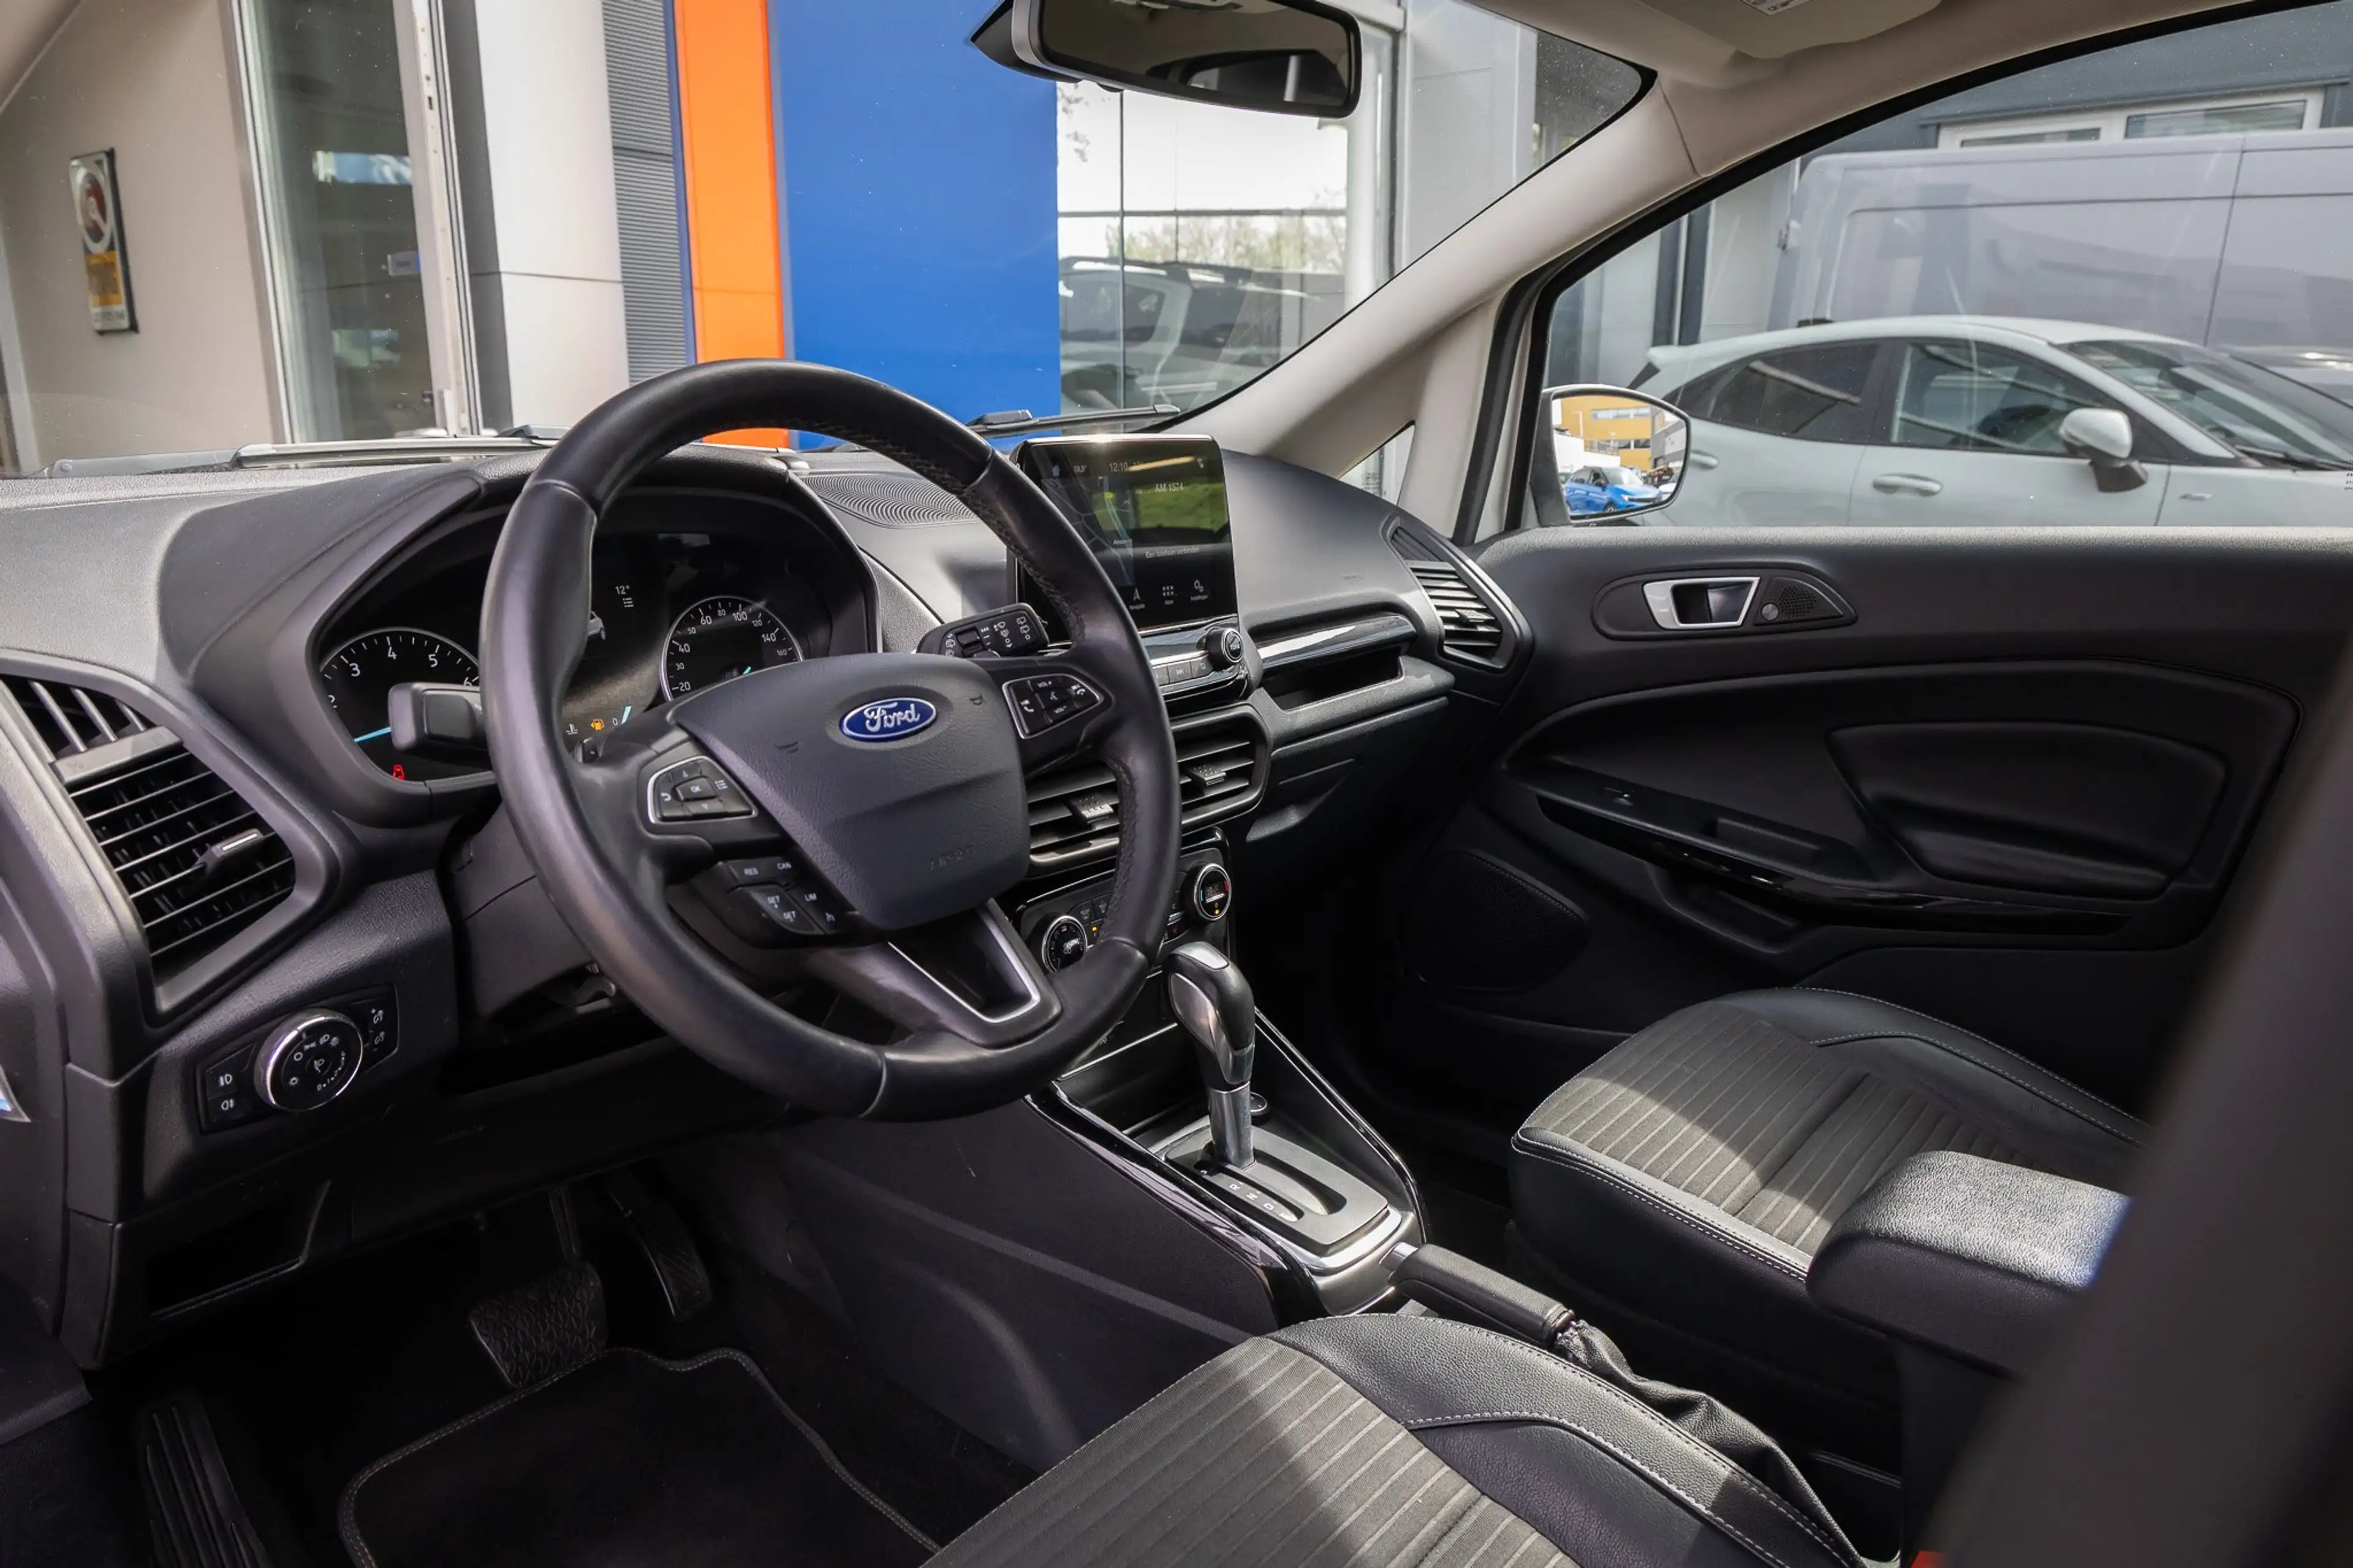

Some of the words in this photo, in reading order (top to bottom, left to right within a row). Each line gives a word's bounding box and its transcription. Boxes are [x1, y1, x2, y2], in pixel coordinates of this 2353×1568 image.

[1168, 482, 1184, 491] 1574
[615, 585, 630, 595] 12°
[700, 615, 712, 625] 60
[732, 611, 748, 621] 100
[762, 632, 776, 642] 140
[387, 646, 397, 660] 4
[678, 643, 690, 653] 40
[428, 654, 438, 667] 5
[349, 663, 360, 676] 3
[679, 681, 691, 691] 20
[864, 702, 920, 732] Ford
[777, 862, 792, 871] CAN
[744, 867, 759, 877] RES
[767, 895, 780, 904] SET
[783, 911, 796, 920] SET
[1229, 1183, 1241, 1192] R
